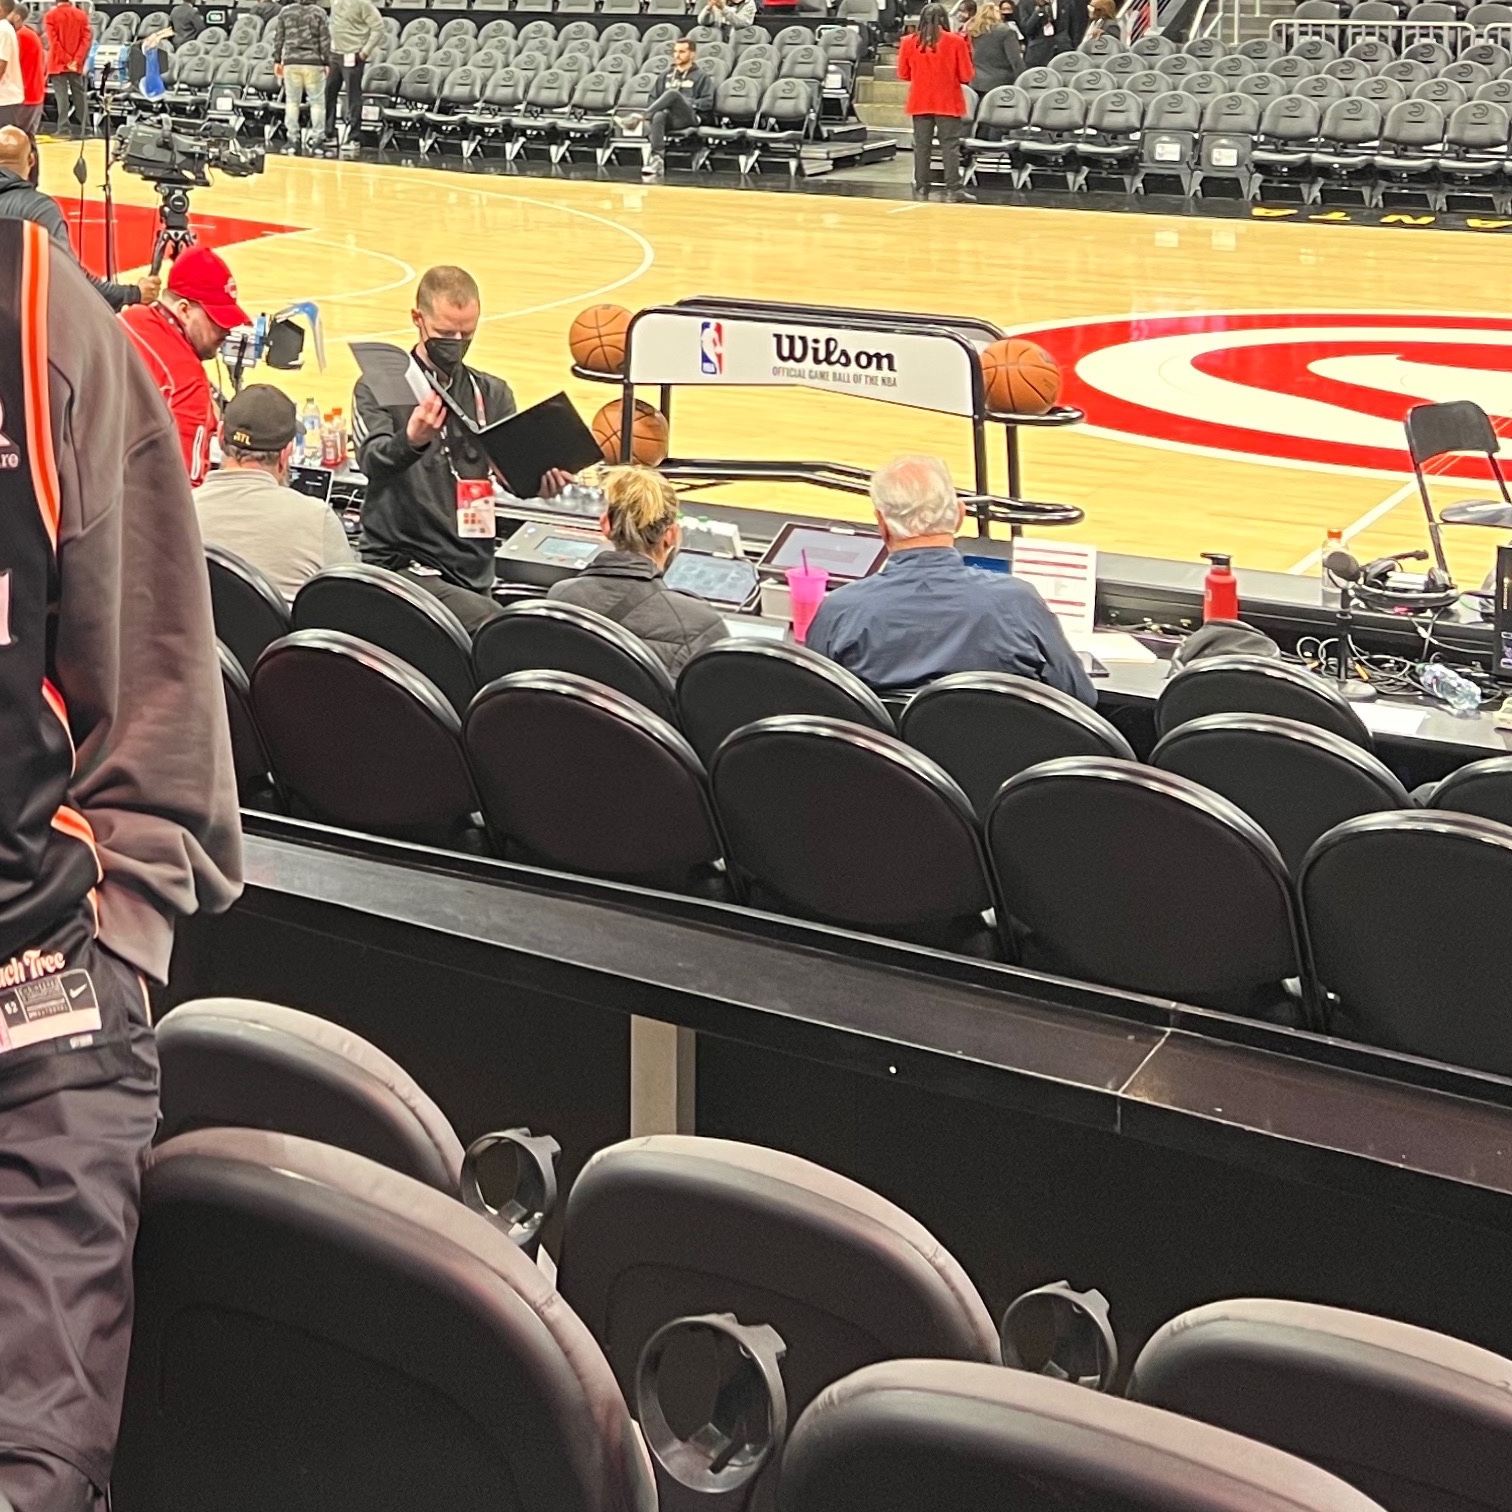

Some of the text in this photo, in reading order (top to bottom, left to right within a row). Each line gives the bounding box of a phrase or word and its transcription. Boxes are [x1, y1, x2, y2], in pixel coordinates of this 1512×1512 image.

[772, 333, 897, 373] Wilson
[772, 366, 898, 388] OFFICIAL GAME BALL OF THE NBA
